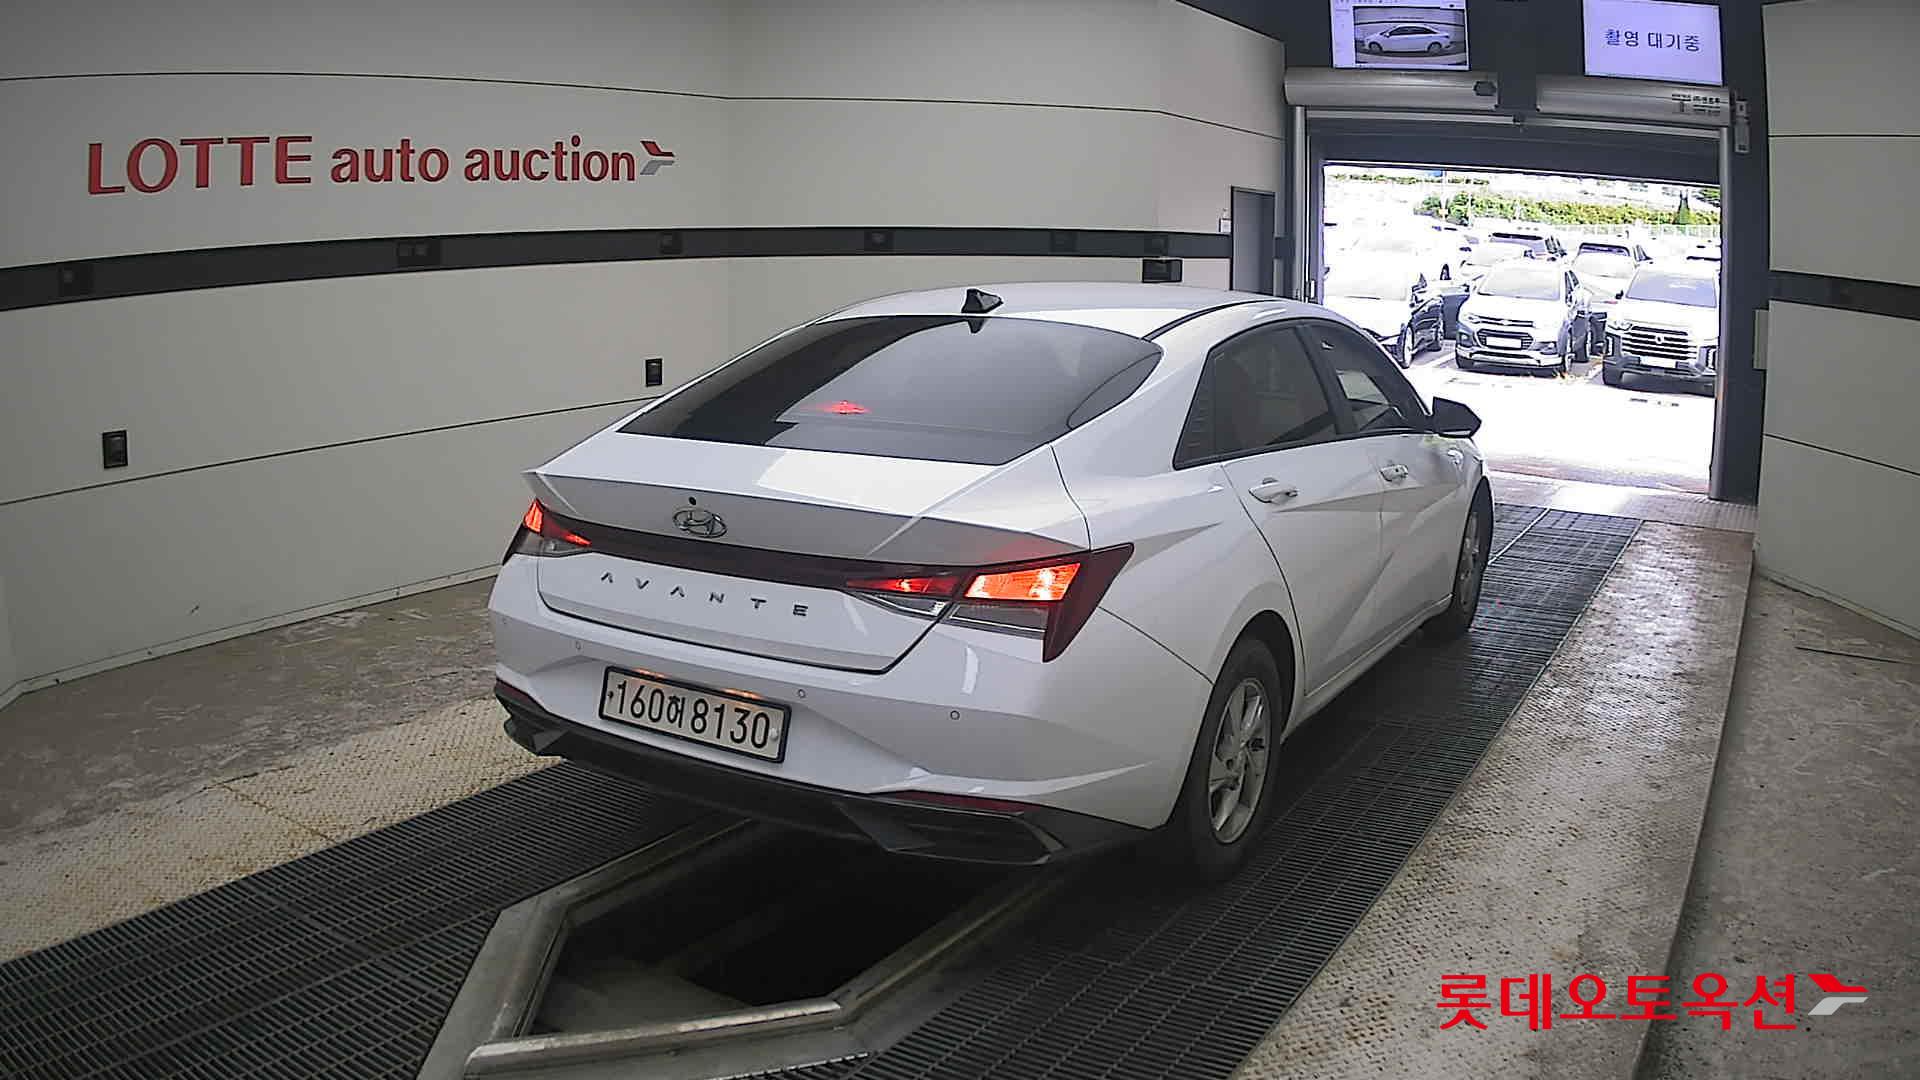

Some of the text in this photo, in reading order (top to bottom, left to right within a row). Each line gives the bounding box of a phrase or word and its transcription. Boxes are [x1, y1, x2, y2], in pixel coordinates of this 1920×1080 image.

[1647, 32, 1700, 52] 대기중
[87, 135, 636, 195] LOTTE auto auction
[600, 571, 809, 617] AVANTE
